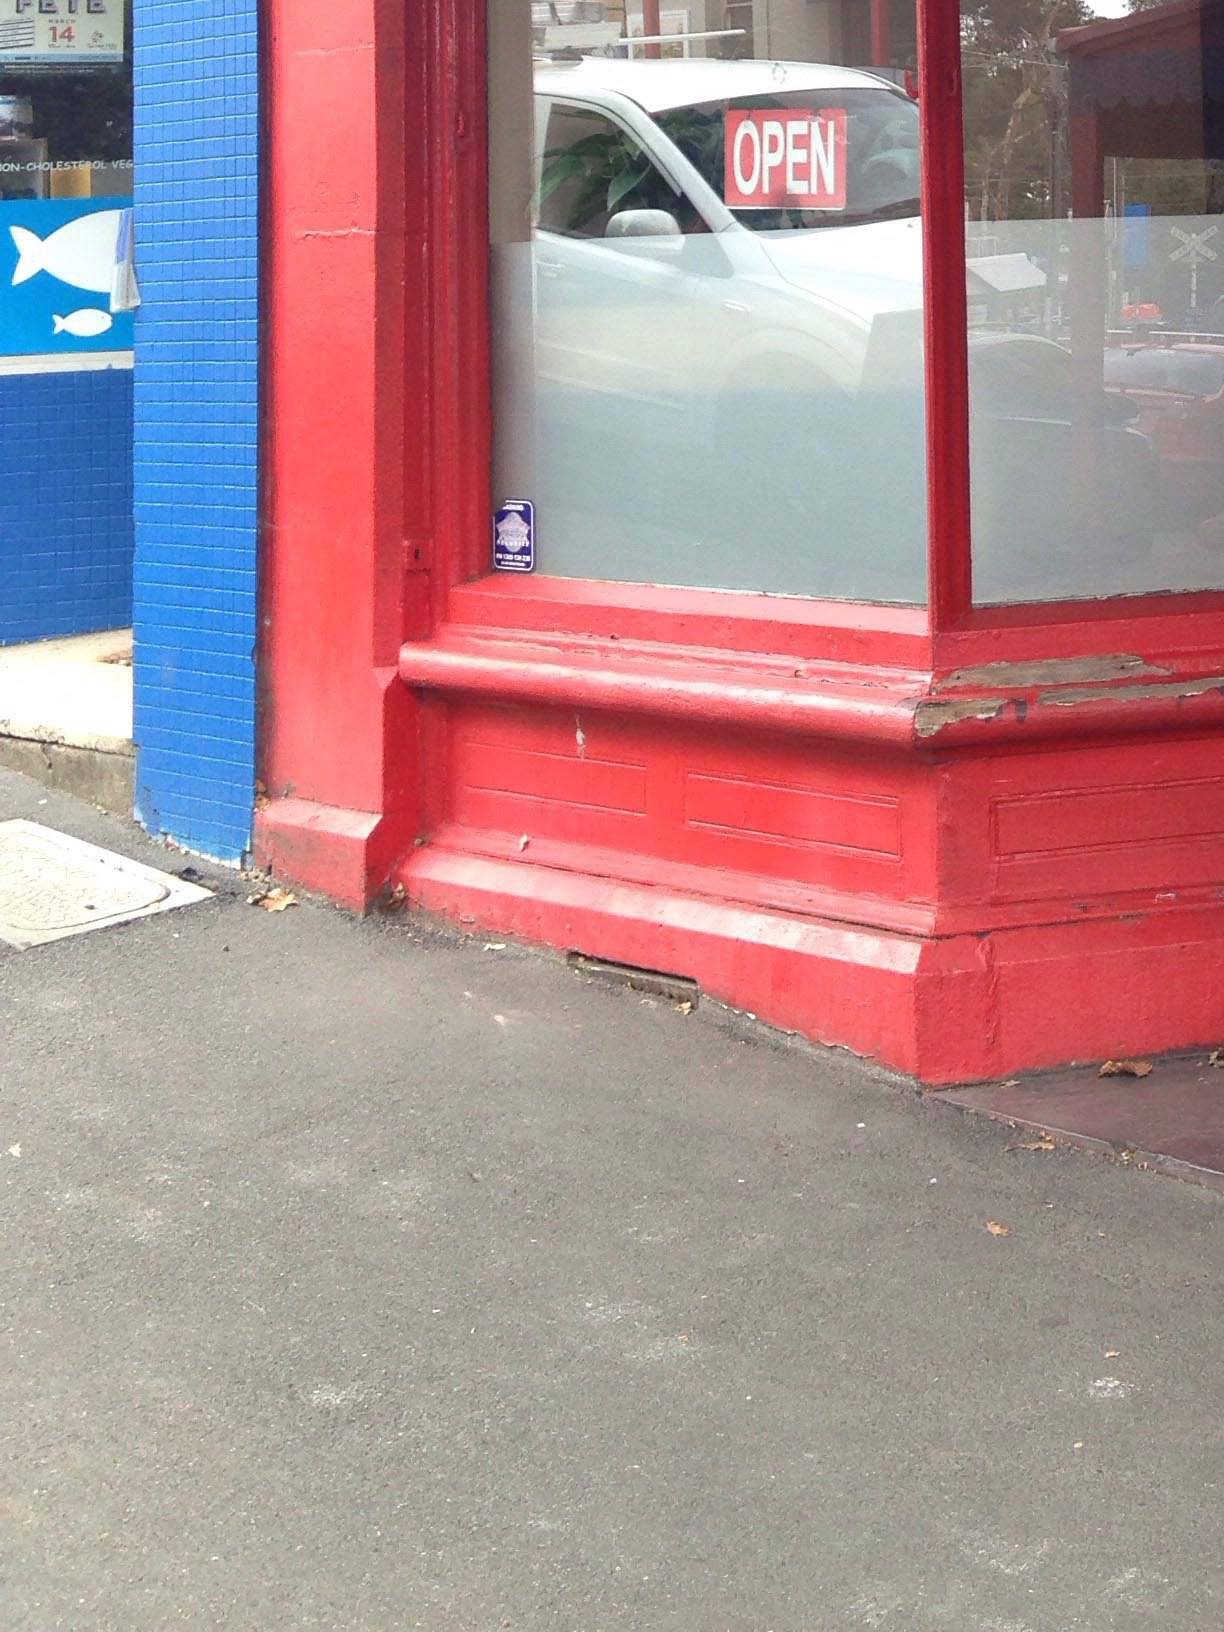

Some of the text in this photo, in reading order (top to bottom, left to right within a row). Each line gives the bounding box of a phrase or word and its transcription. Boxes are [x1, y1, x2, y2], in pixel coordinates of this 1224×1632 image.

[48, 25, 76, 43] 14
[0, 160, 107, 172] ON-CHOLESTEROL
[733, 119, 835, 196] OPEN
